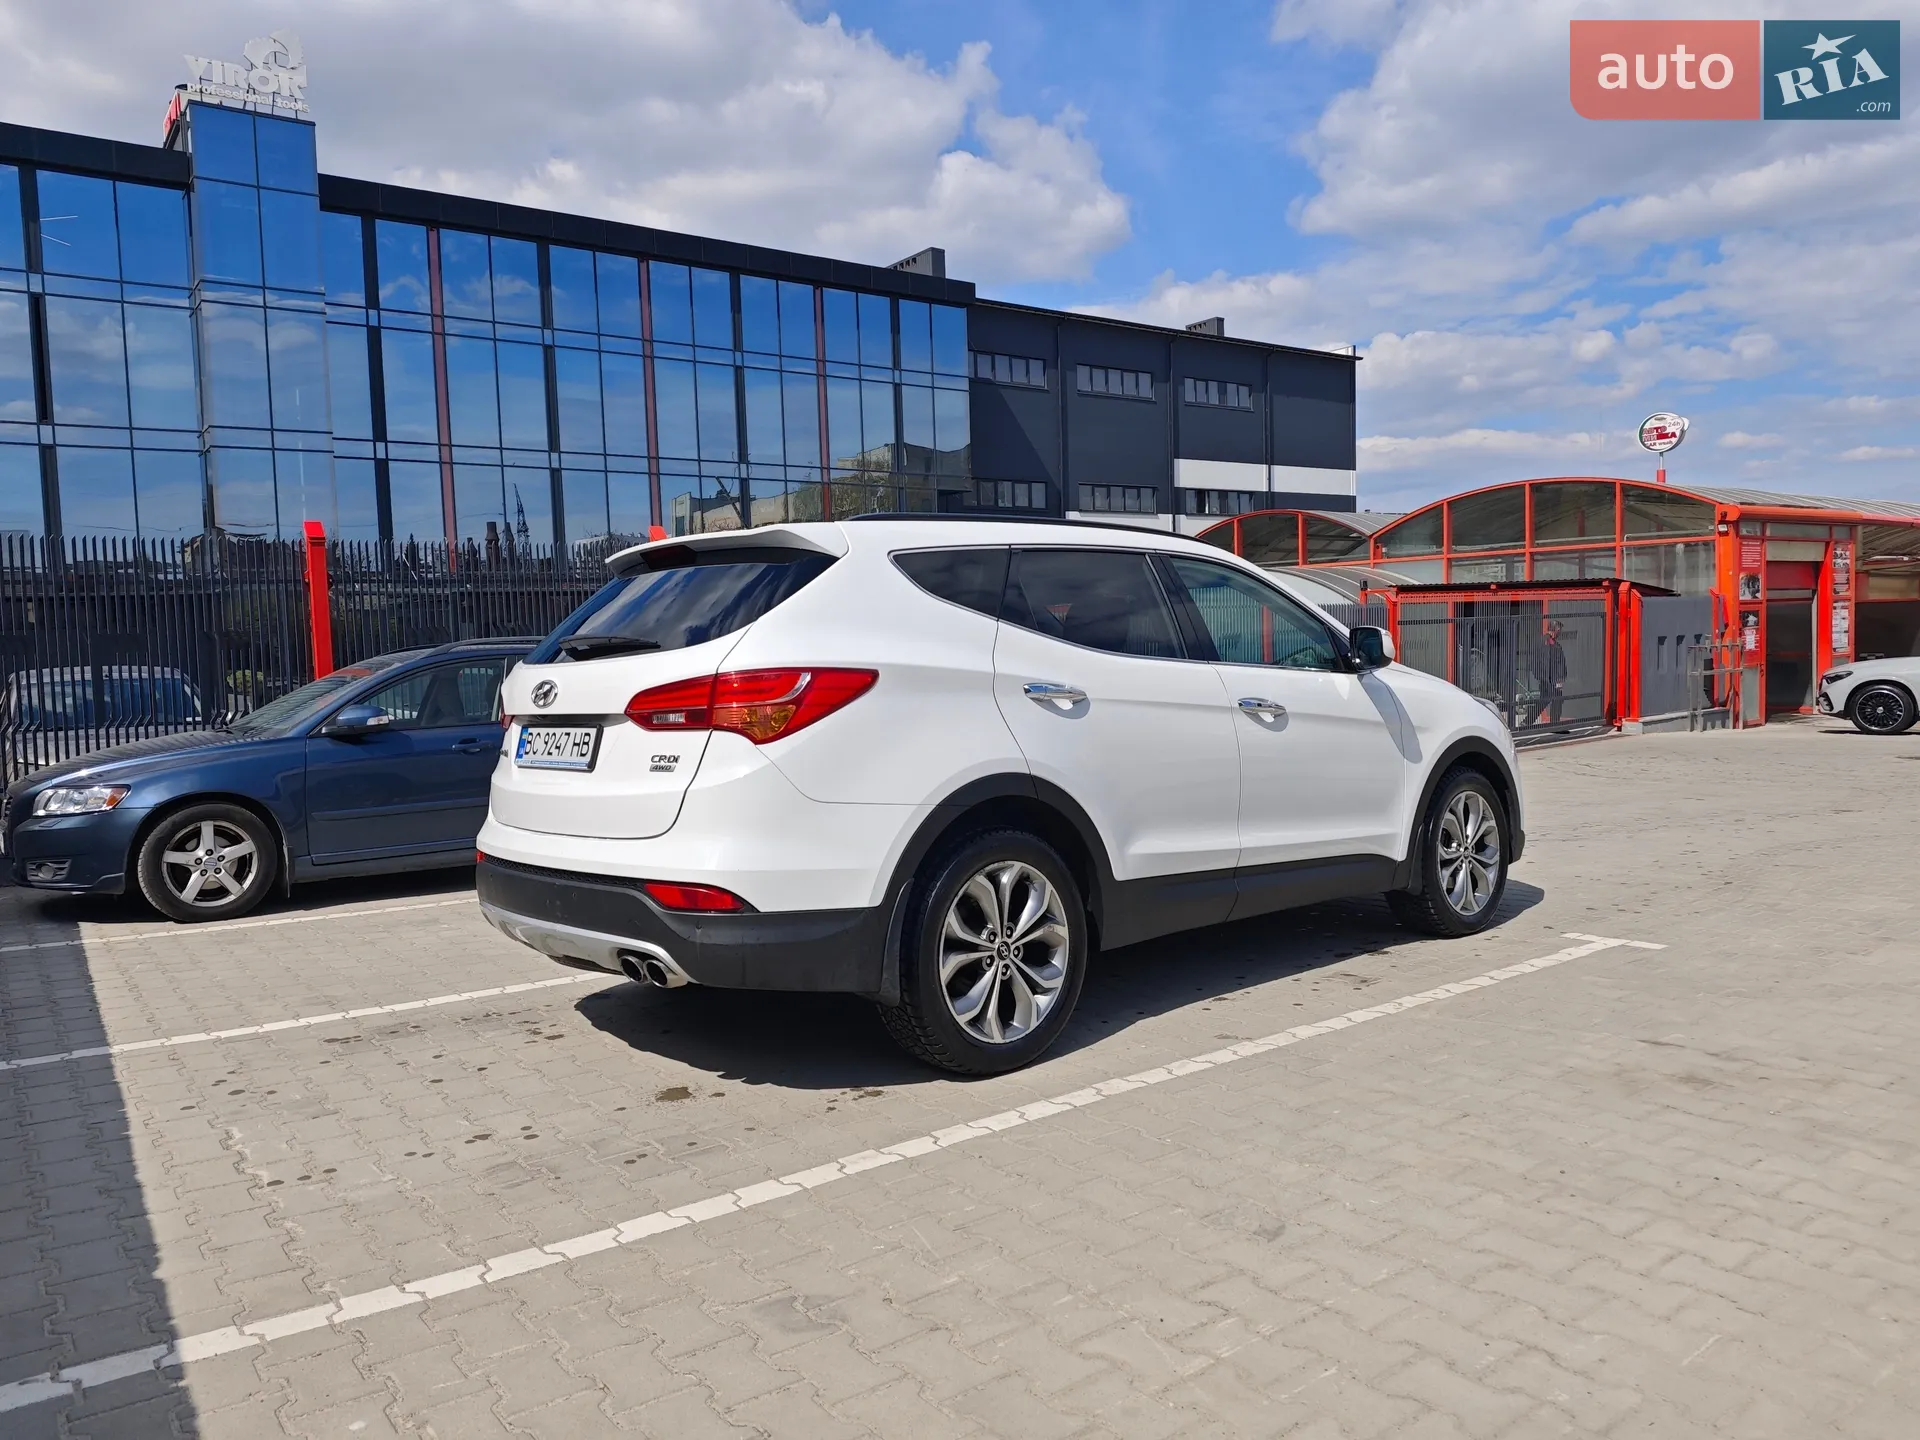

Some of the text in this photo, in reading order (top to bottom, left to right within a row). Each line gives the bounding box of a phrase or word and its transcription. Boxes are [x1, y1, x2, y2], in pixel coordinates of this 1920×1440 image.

[183, 54, 308, 100] VIROK
[187, 82, 311, 113] professional tools
[524, 732, 542, 756] BC
[541, 732, 572, 757] 9247
[570, 732, 592, 758] HB
